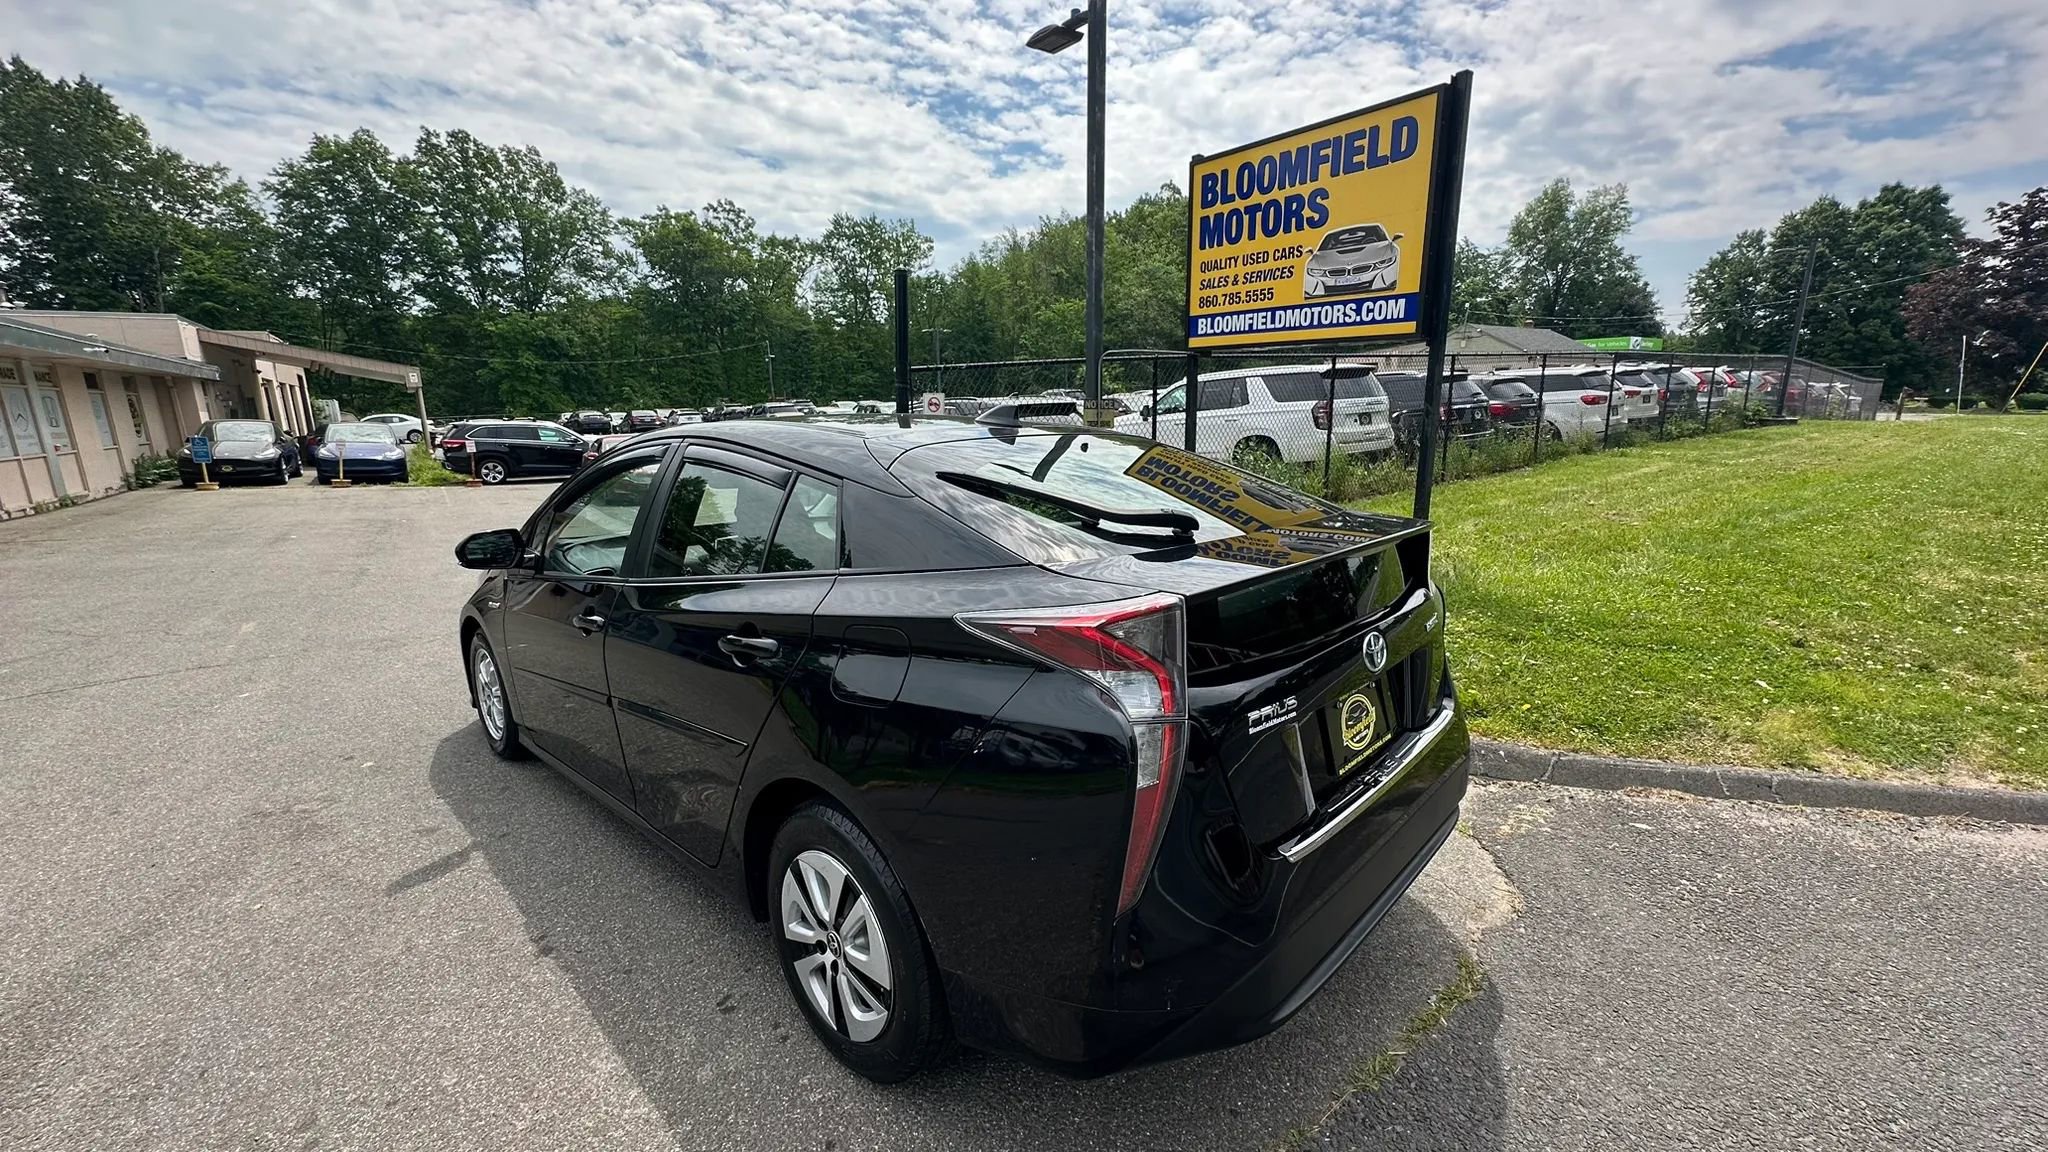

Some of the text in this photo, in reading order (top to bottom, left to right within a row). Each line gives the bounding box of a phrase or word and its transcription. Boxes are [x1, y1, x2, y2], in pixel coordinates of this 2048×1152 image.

[1200, 115, 1419, 210] BLOOMFIELD
[1199, 187, 1330, 250] MOTORS
[1200, 244, 1304, 274] QUALITY USED CARS
[1199, 265, 1295, 291] SALES & SERVICES
[1198, 287, 1274, 309] 860.785.5555
[1197, 298, 1406, 336] BLOOMFIELDMOTORS.COM
[1085, 399, 1114, 409] NOICE
